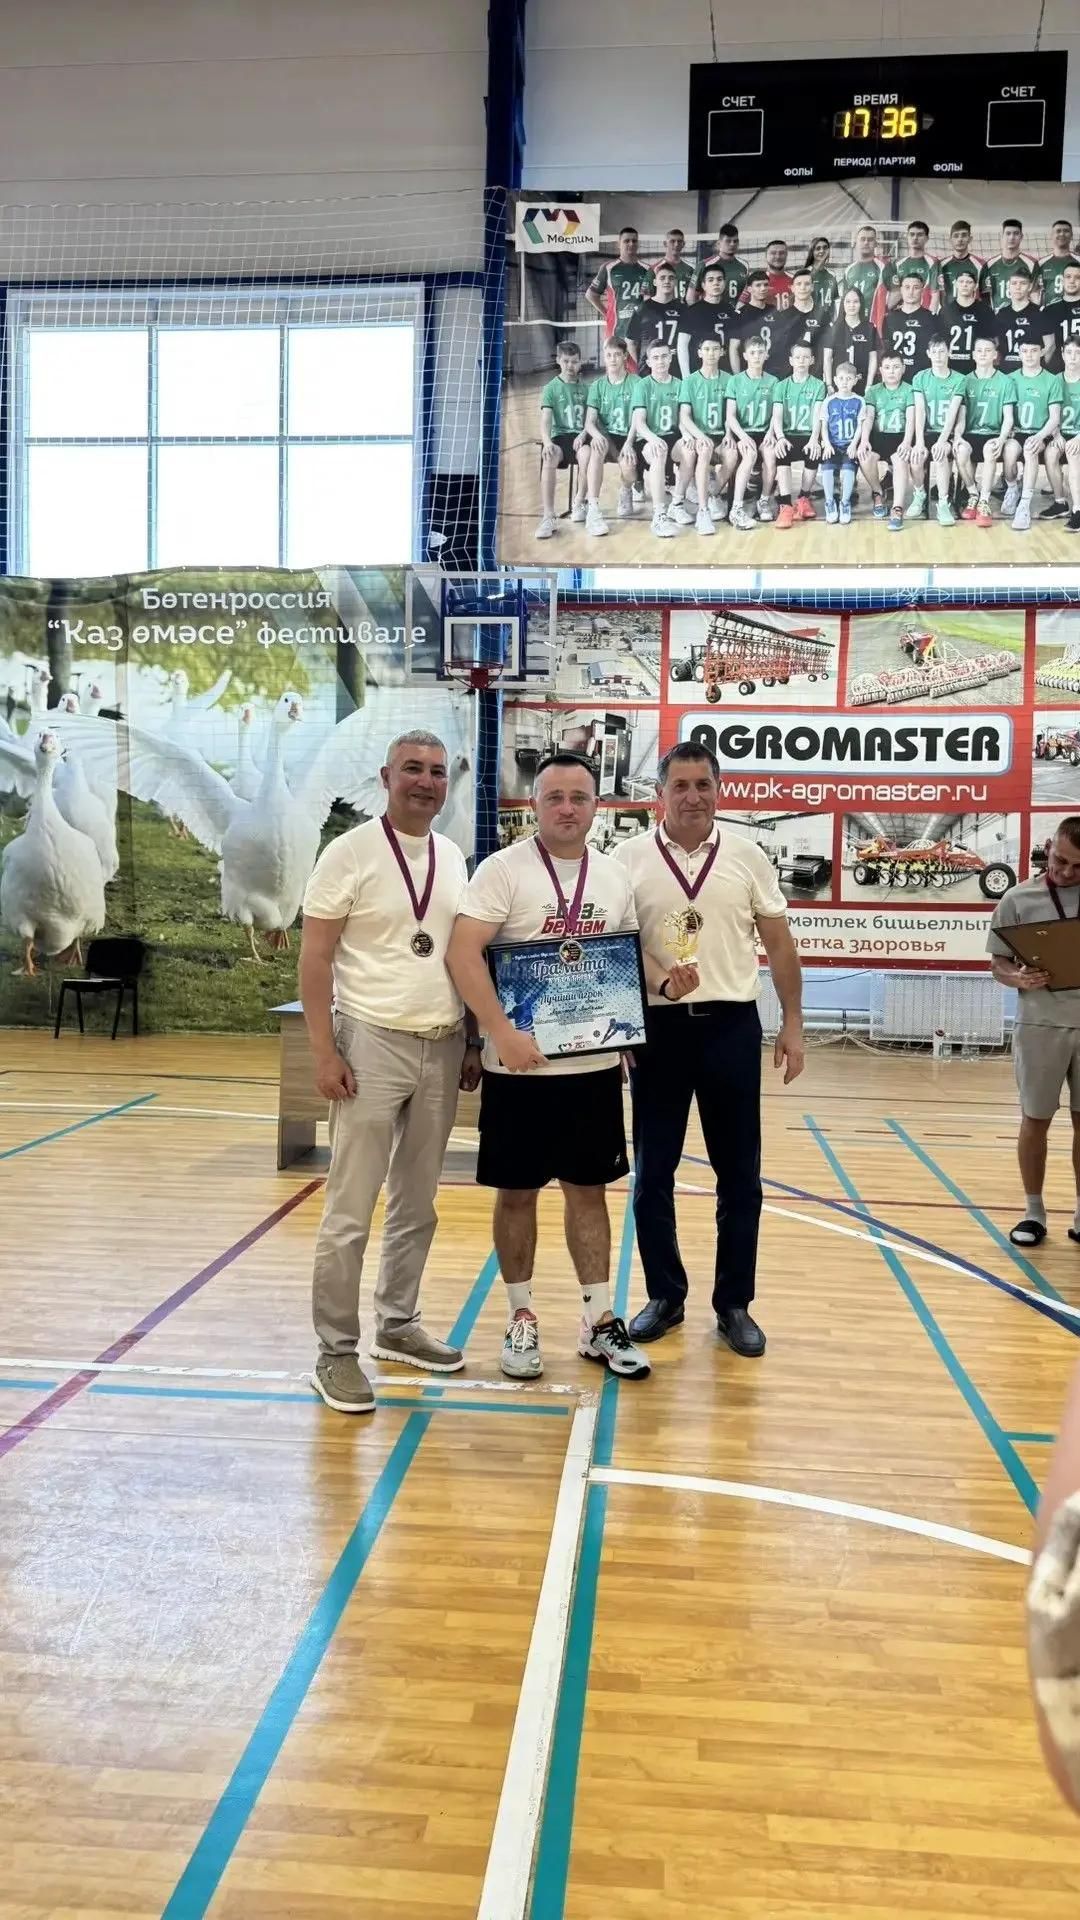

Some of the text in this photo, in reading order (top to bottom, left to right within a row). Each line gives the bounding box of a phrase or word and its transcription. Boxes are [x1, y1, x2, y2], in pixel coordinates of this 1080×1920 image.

[722, 95, 756, 108] СЧЕТ
[853, 93, 898, 106] ВРЕМЯ
[1001, 85, 1036, 98] СЧЕТ
[844, 107, 917, 138] 17 36
[784, 167, 813, 177] ФОЛЫ
[833, 157, 872, 168] ПЕРИОД
[879, 156, 916, 166] ПАРТИЯ
[933, 163, 963, 173] ФОЛЫ
[622, 281, 640, 300] 24
[775, 292, 790, 310] 16
[819, 287, 832, 307] 14
[655, 320, 678, 345] 17
[892, 331, 916, 356] 23
[949, 325, 973, 352] 21
[564, 404, 584, 429] 13
[660, 406, 672, 431] 8
[707, 402, 719, 428] 5
[747, 400, 768, 427] 11
[788, 404, 810, 431] 12
[878, 408, 902, 432] 14
[928, 400, 951, 426] 15
[977, 402, 988, 426] 7
[837, 418, 855, 439] 10
[257, 622, 426, 648] фестивале
[690, 724, 1000, 761] AGROMASTER
[719, 778, 987, 805] ww.pk-agromaster.ru
[849, 937, 946, 954] здоровья
